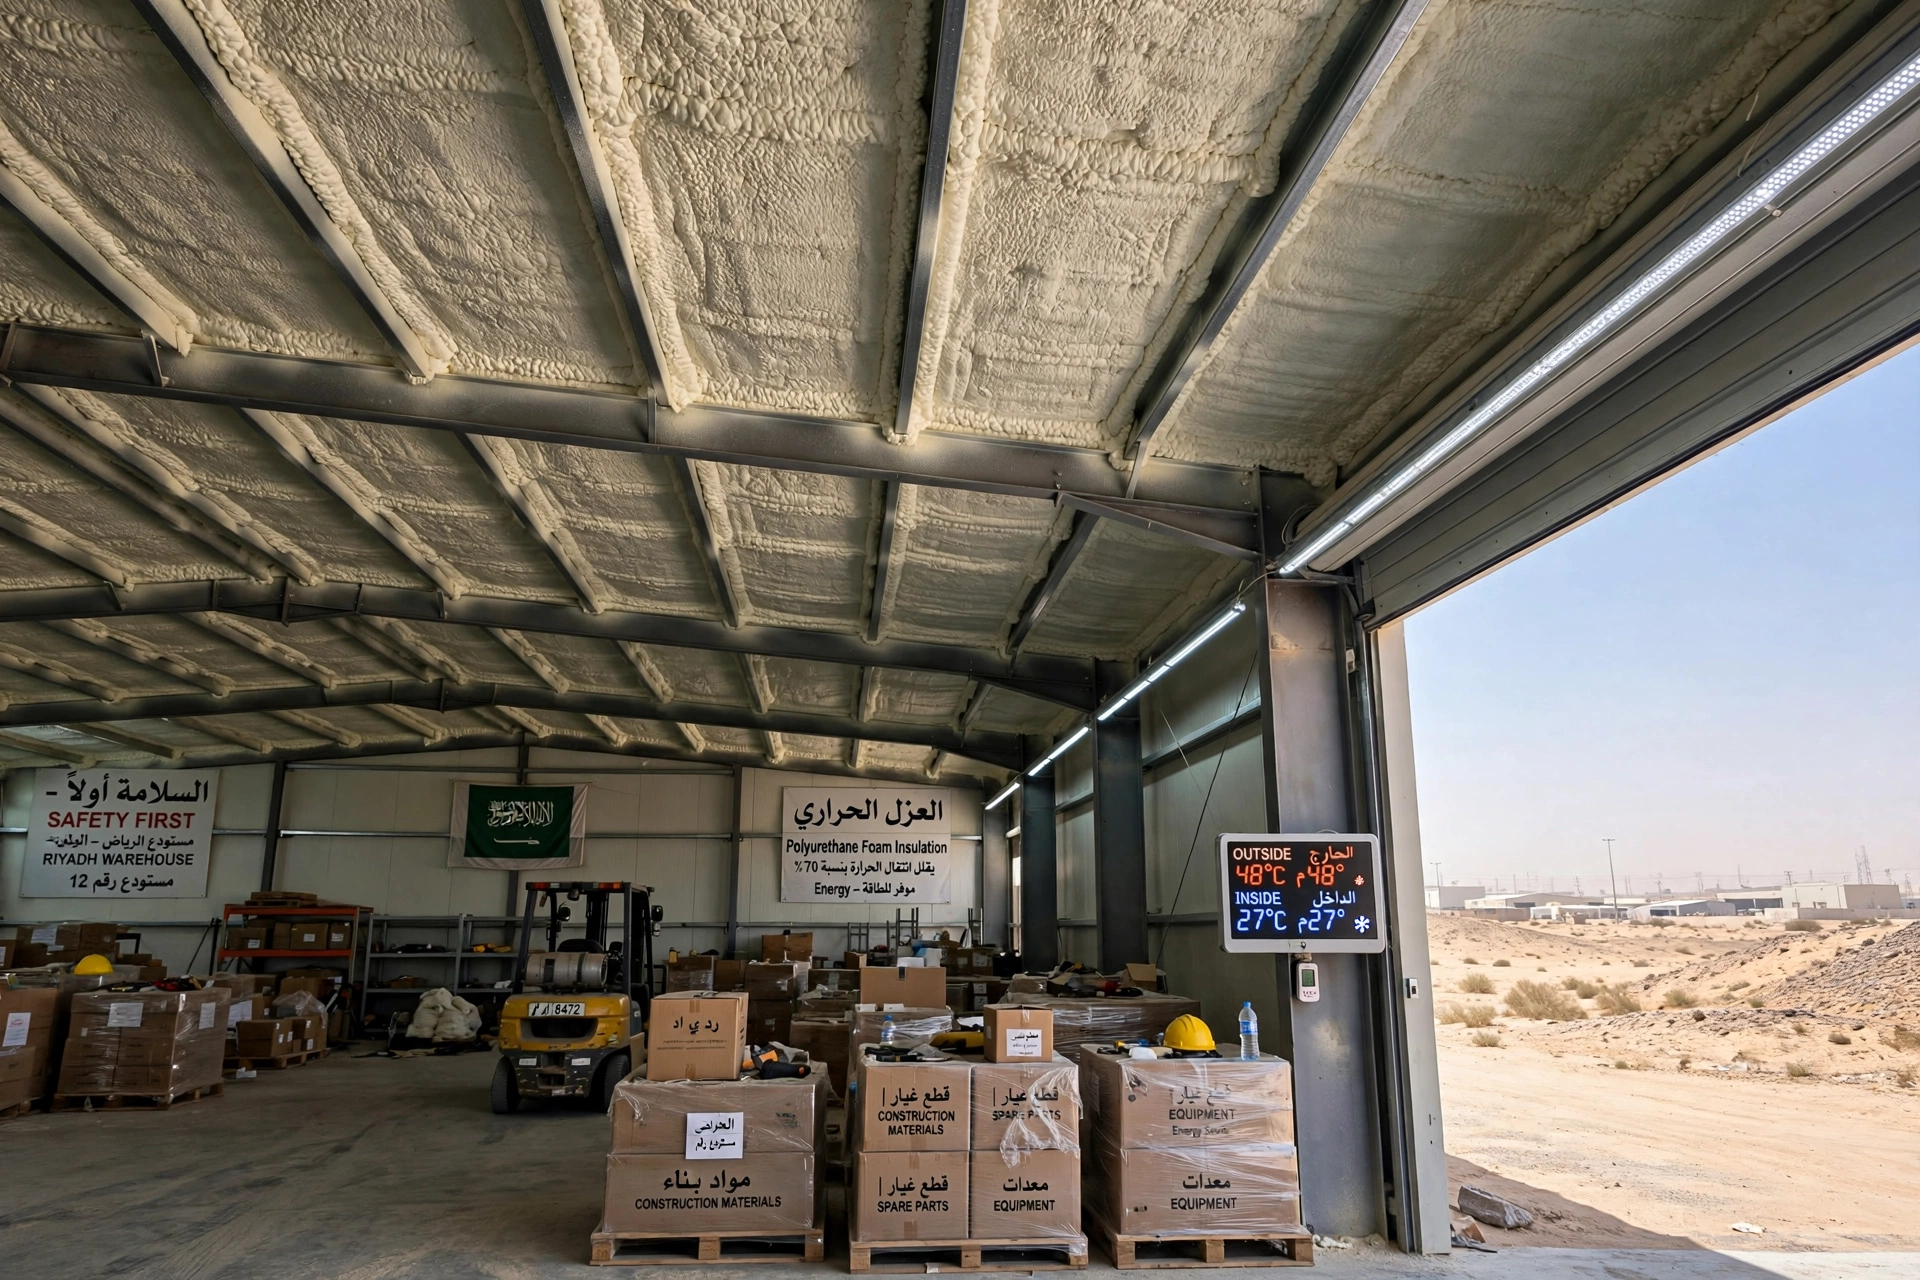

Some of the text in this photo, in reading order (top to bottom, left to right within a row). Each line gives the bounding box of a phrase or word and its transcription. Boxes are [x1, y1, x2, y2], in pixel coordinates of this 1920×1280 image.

[117, 778, 208, 804] السلامة
[47, 812, 195, 829] SAFETY FIRST
[794, 798, 943, 830] العزل الحراري
[102, 835, 144, 850] الرياض
[148, 836, 194, 852] مستودع
[786, 839, 947, 856] Polyurethane Foam Insulation
[43, 853, 194, 866] RIYADH WAREHOUSE
[1233, 848, 1291, 860] OUTSIDE
[850, 861, 881, 876] الحرارة
[1236, 863, 1285, 885] 48°C
[70, 873, 173, 893] مستودع رقم 12
[815, 882, 850, 898] Energy
[862, 882, 891, 894] للطاقة
[894, 882, 915, 897] موفر
[1235, 892, 1281, 905] INSIDE
[1313, 891, 1355, 907] الداخل
[1237, 909, 1287, 931] 27°C
[555, 1004, 580, 1014] 8472
[890, 1087, 918, 1107] غيار
[923, 1086, 949, 1108] قطع
[878, 1111, 955, 1121] CONSTRUCTION
[1169, 1109, 1235, 1119] EQUIPMENT
[888, 1124, 943, 1135] MATERIALS
[664, 1169, 750, 1194] مواد بناء
[888, 1177, 915, 1196] غيار
[920, 1175, 948, 1198] قطع
[1003, 1177, 1048, 1191] معدات
[1183, 1173, 1231, 1189] معدات
[635, 1196, 781, 1209] CONSTRUCTION MATERIALS
[877, 1200, 949, 1212] SPARE PARTS
[994, 1200, 1055, 1211] EQUIPMENT
[1171, 1197, 1237, 1210] EQUIPMENT
